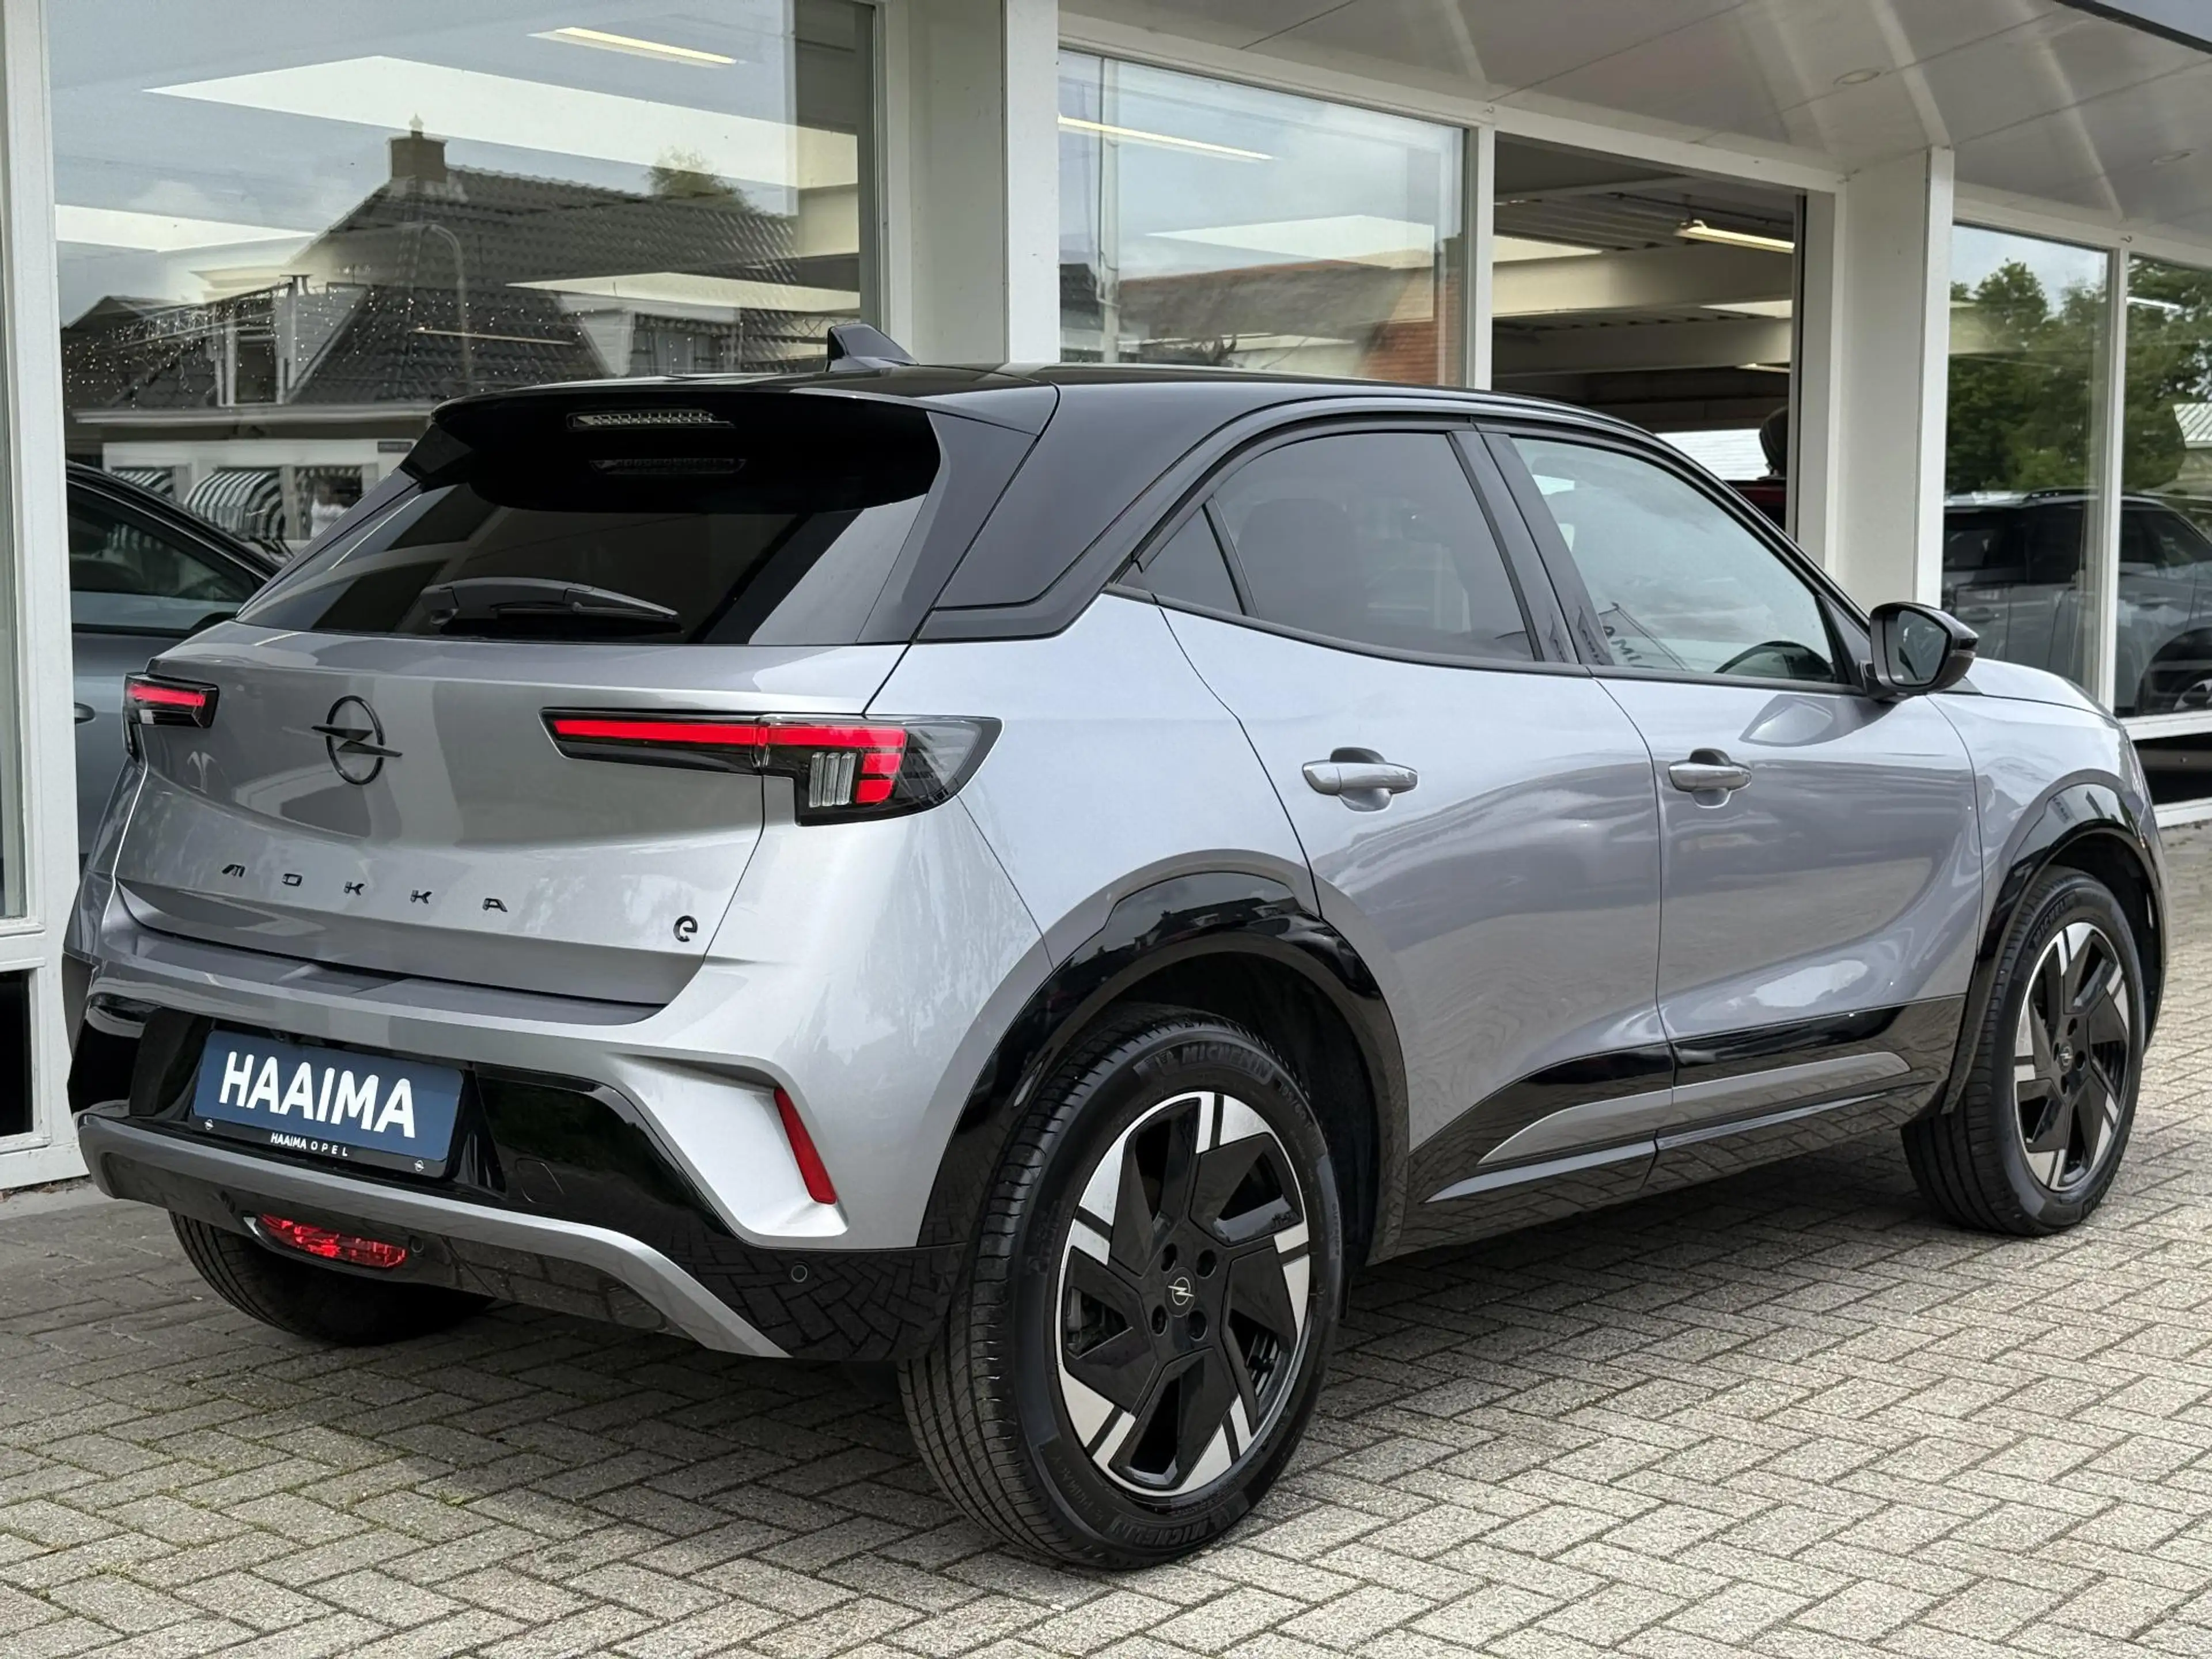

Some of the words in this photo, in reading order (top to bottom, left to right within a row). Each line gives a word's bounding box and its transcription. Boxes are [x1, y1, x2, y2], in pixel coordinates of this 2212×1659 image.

[222, 863, 507, 913] MOKKA
[219, 1051, 415, 1138] HAAIMA
[270, 1132, 306, 1150] HAAIMA
[310, 1141, 348, 1157] OPEL
